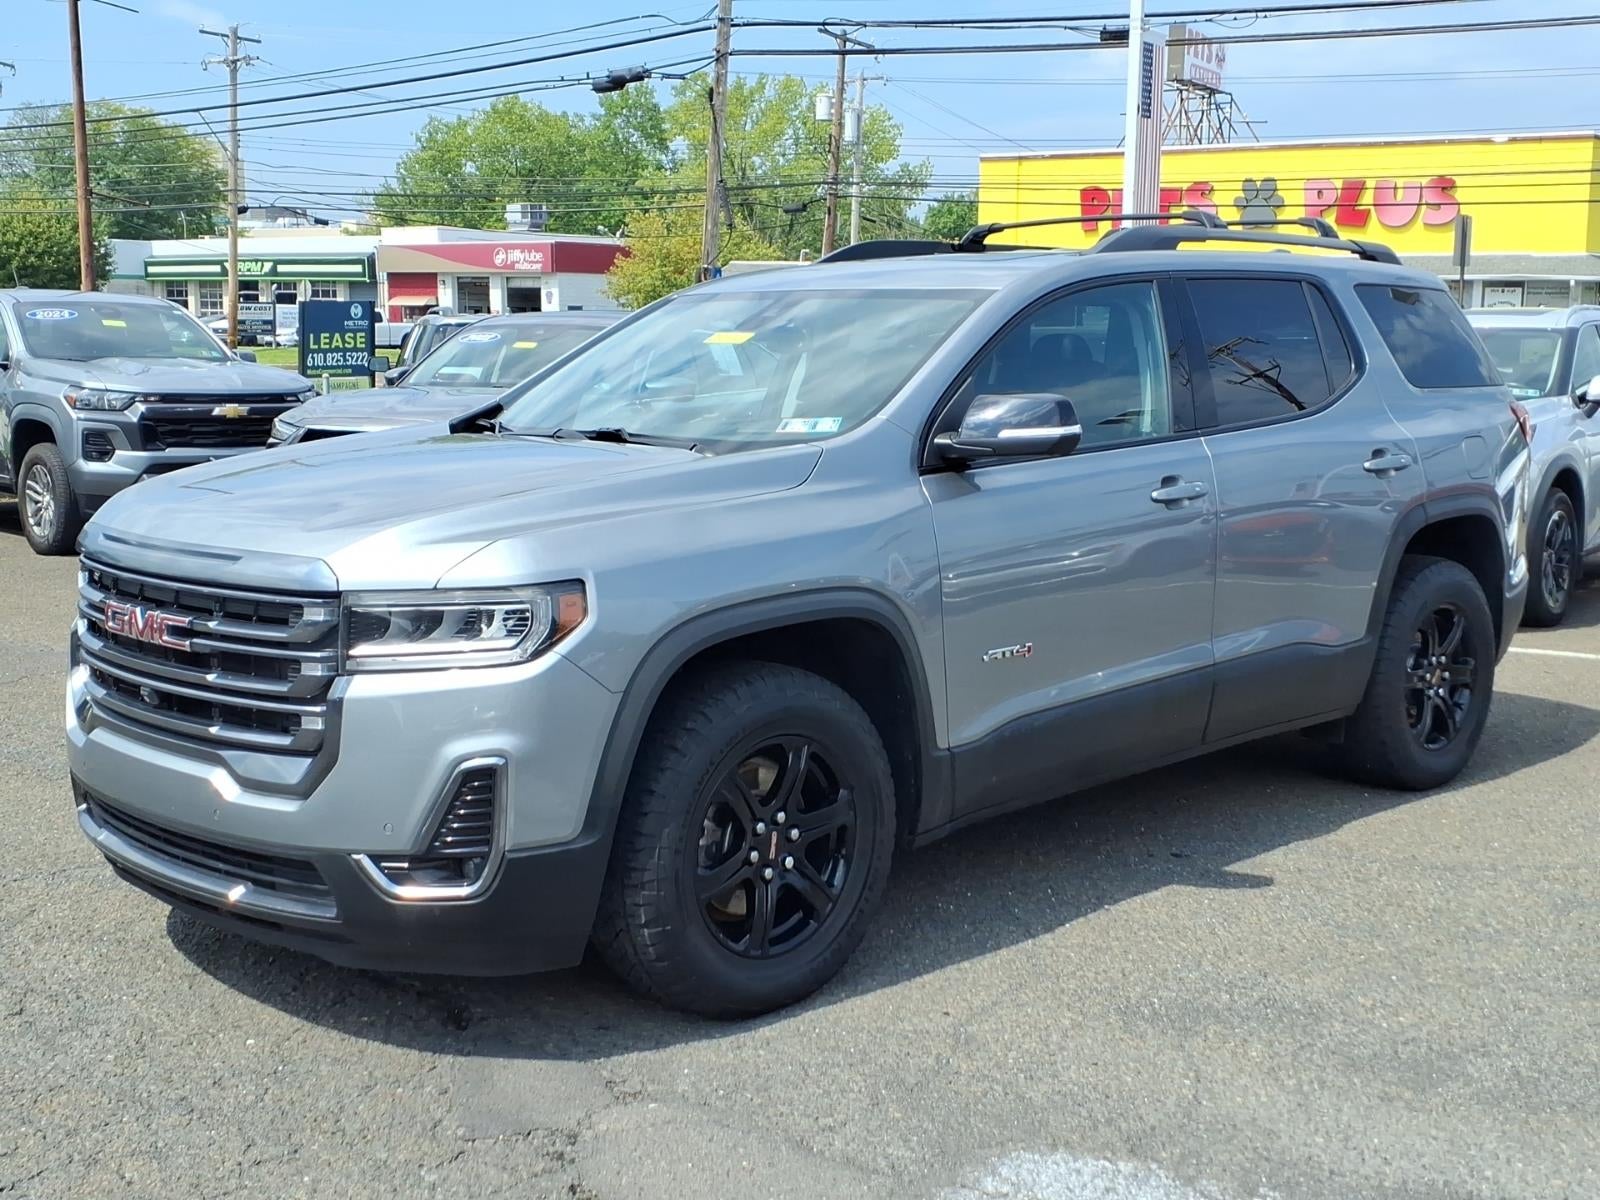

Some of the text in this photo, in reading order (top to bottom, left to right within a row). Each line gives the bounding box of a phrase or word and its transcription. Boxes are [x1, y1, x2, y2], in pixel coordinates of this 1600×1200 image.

[1304, 176, 1460, 227] PLUS
[237, 261, 263, 272] RPM
[35, 310, 70, 319] 2024
[309, 332, 366, 349] LEASE
[306, 351, 369, 367] 610.825.5222
[105, 600, 189, 652] GMC
[983, 642, 1033, 662] AT4
